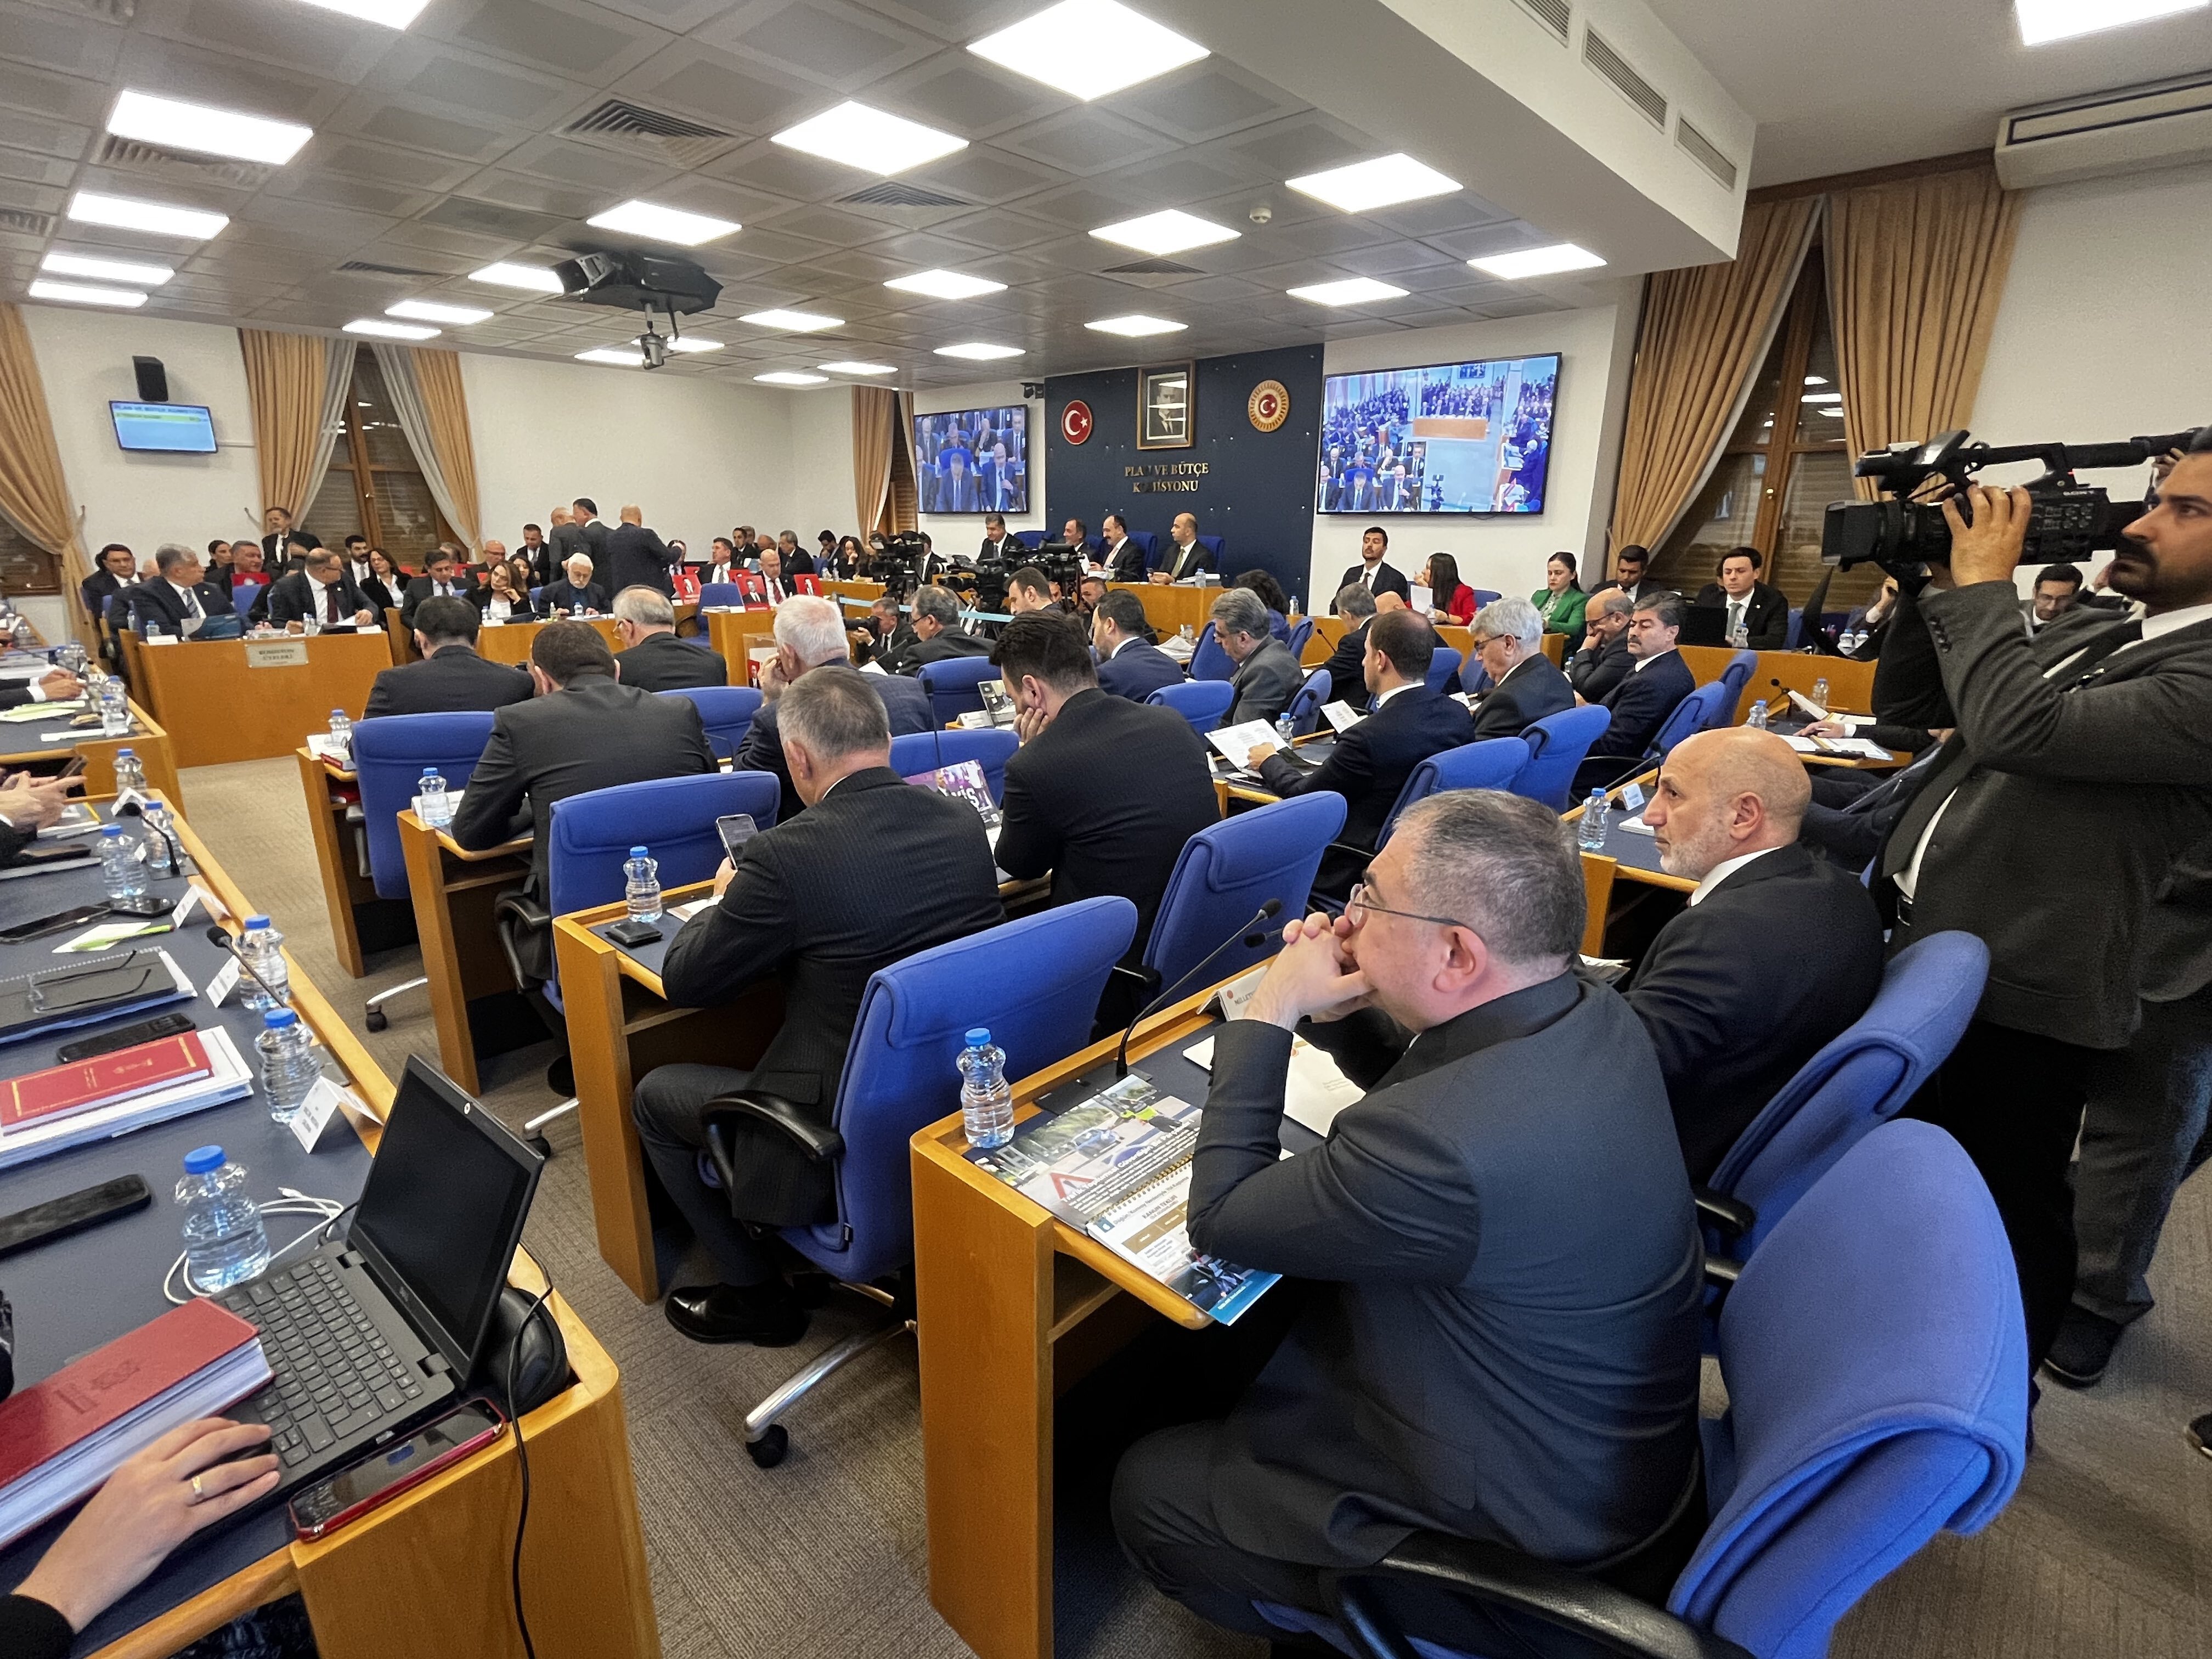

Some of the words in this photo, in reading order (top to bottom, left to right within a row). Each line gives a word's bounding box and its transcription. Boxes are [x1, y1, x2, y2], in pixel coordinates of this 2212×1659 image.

[1154, 465, 1168, 476] VE
[1171, 461, 1209, 477] BÜTÇE
[1132, 479, 1199, 493] KİSYONU
